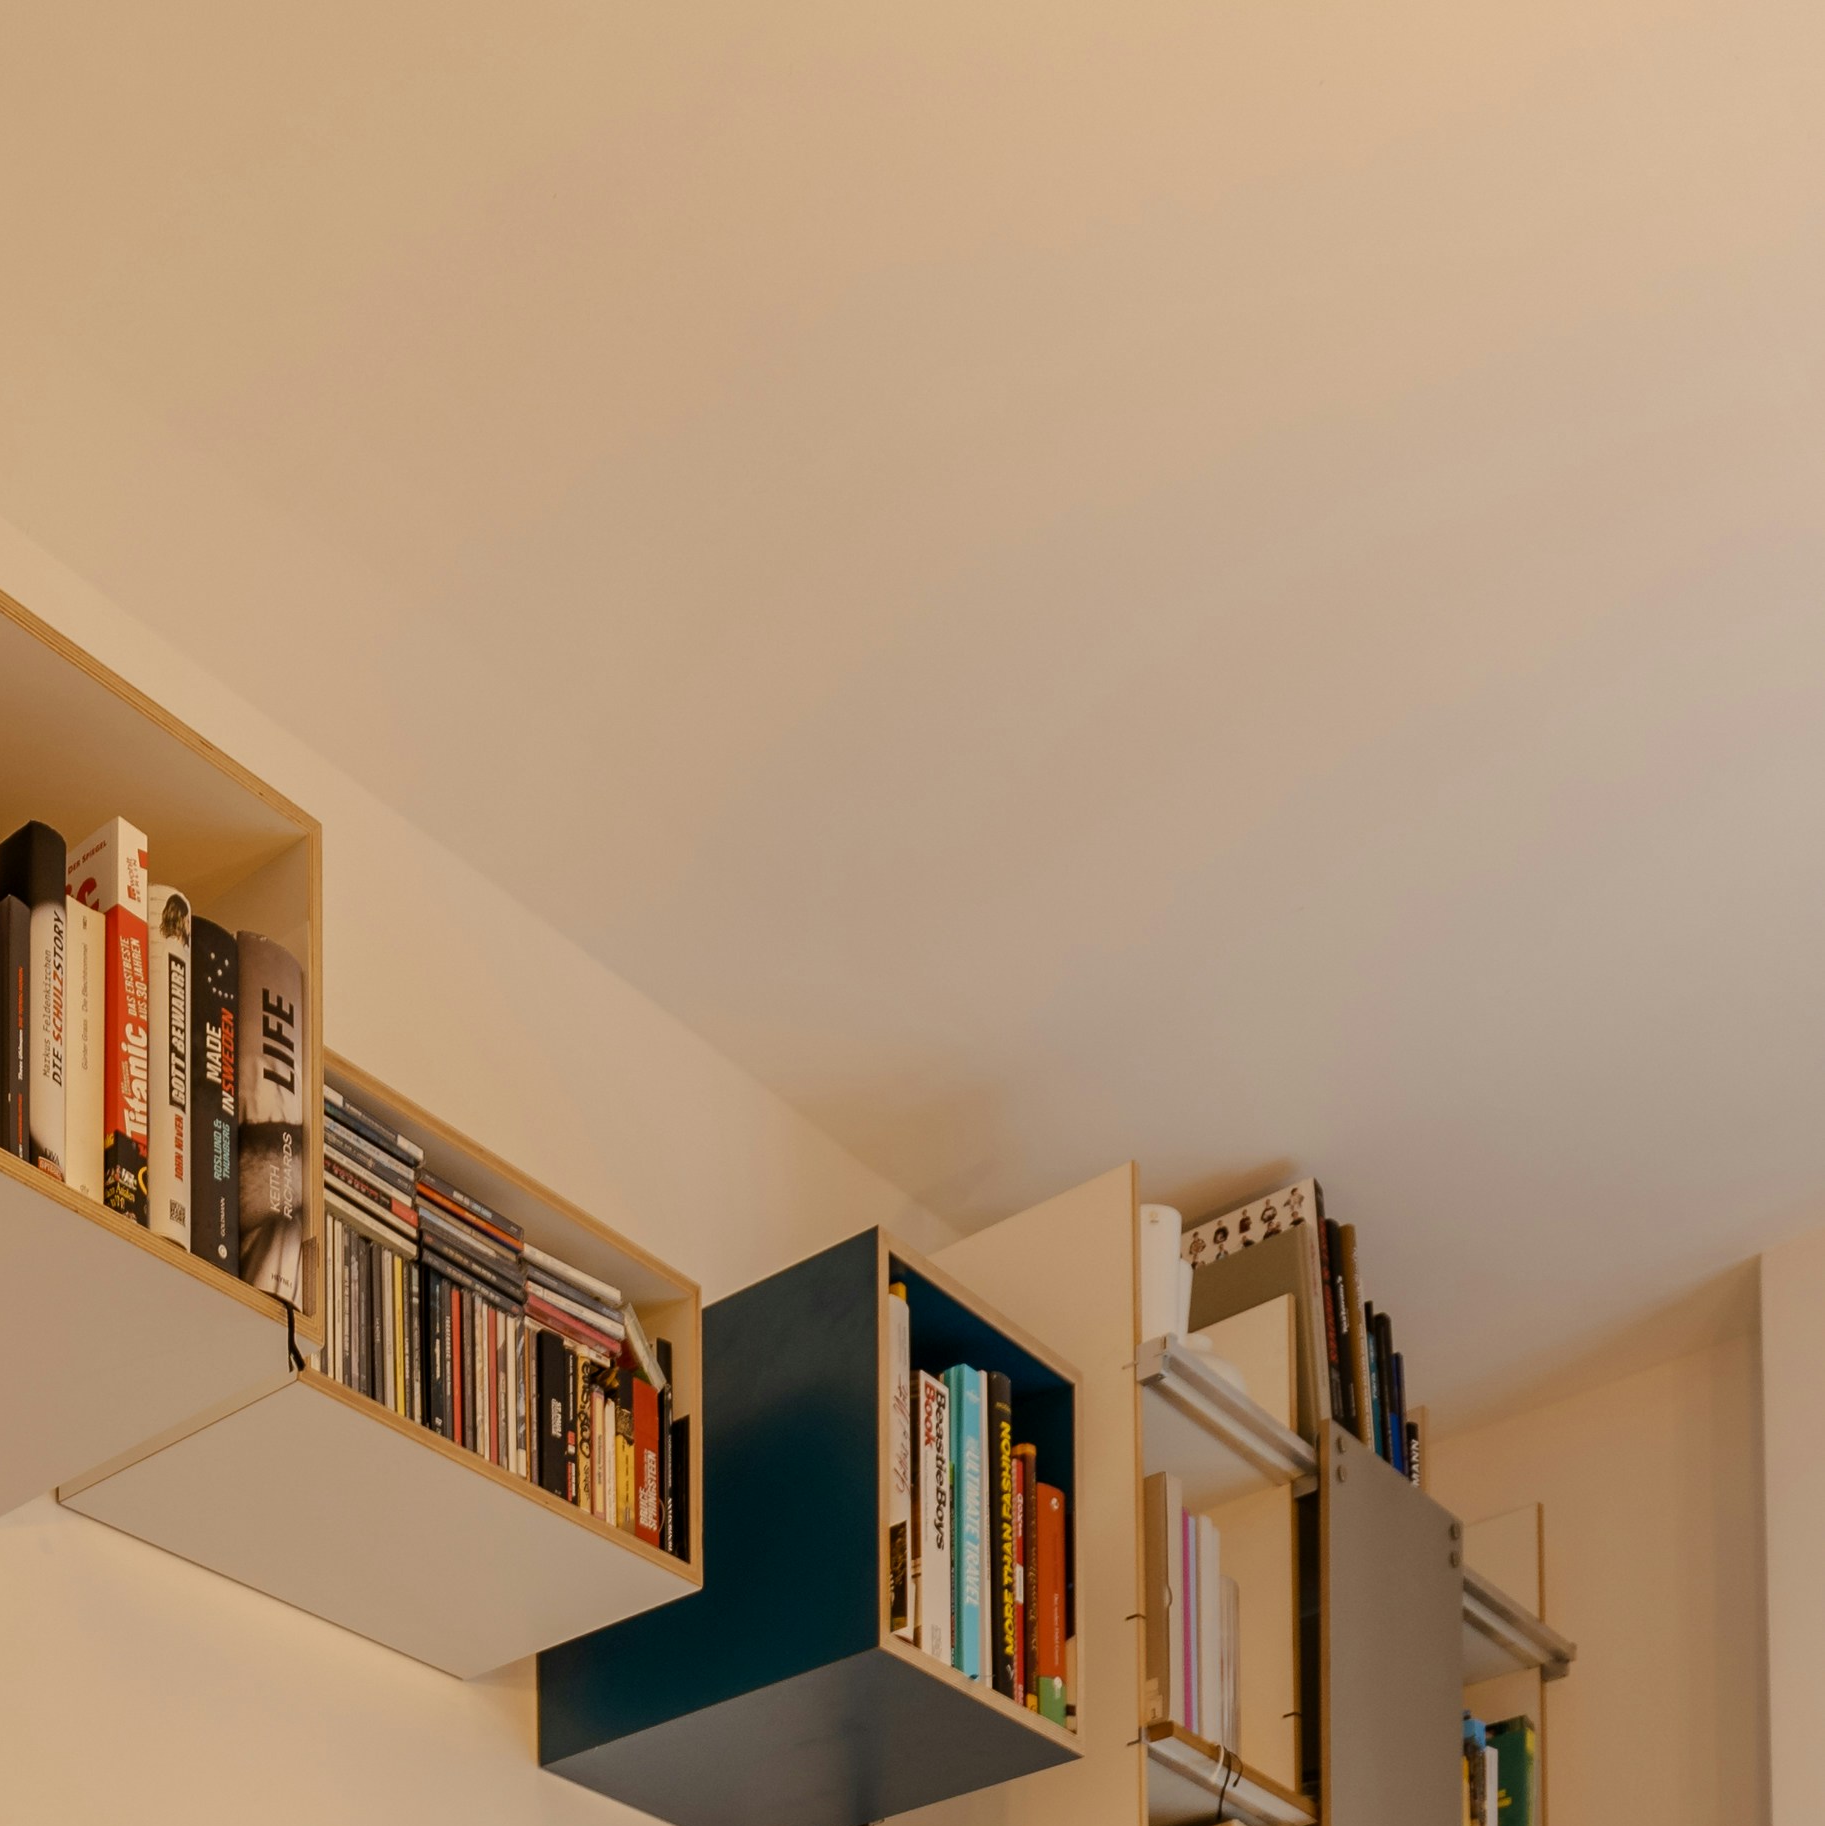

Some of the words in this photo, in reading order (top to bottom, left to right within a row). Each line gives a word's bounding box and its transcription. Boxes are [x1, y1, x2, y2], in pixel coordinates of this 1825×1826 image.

[68, 858, 80, 876] DER
[81, 840, 108, 867] SPIEGEL
[81, 942, 89, 996] Blechtrommel
[119, 936, 135, 993] ERSTBESTE
[131, 938, 147, 980] JAHREN
[43, 949, 52, 1031] Feldenkirchen
[81, 999, 89, 1011] Die
[127, 995, 136, 1017] DAS
[137, 982, 147, 1002] 30
[138, 1002, 148, 1022] AUS
[170, 960, 188, 1049] BEWAHRE
[81, 1018, 89, 1041] Grass
[205, 1021, 220, 1083] MADE
[263, 987, 295, 1096] LIFE
[42, 1034, 51, 1078] Markus
[52, 1052, 64, 1087] DIE
[81, 1044, 89, 1070] Günter
[170, 1053, 187, 1105] GOTT
[125, 1022, 149, 1144] Titanic
[174, 1114, 184, 1151] NIVEN
[214, 1119, 223, 1130] &
[174, 1153, 184, 1183] JOHN
[213, 1131, 223, 1181] ROSLUND
[221, 1123, 231, 1180] THUNBERG
[283, 1132, 293, 1220] RICHARDS
[269, 1164, 280, 1213] KEITH
[924, 1382, 935, 1448] Book
[644, 1448, 658, 1533] SPRINGSTEEN
[965, 1450, 980, 1538] ULTIMATE
[1000, 1421, 1012, 1523] FASHION
[639, 1484, 648, 1529] BRUCE
[965, 1540, 980, 1607] TRAVEL
[1003, 1529, 1014, 1586] THAN
[1004, 1588, 1015, 1655] MORE
